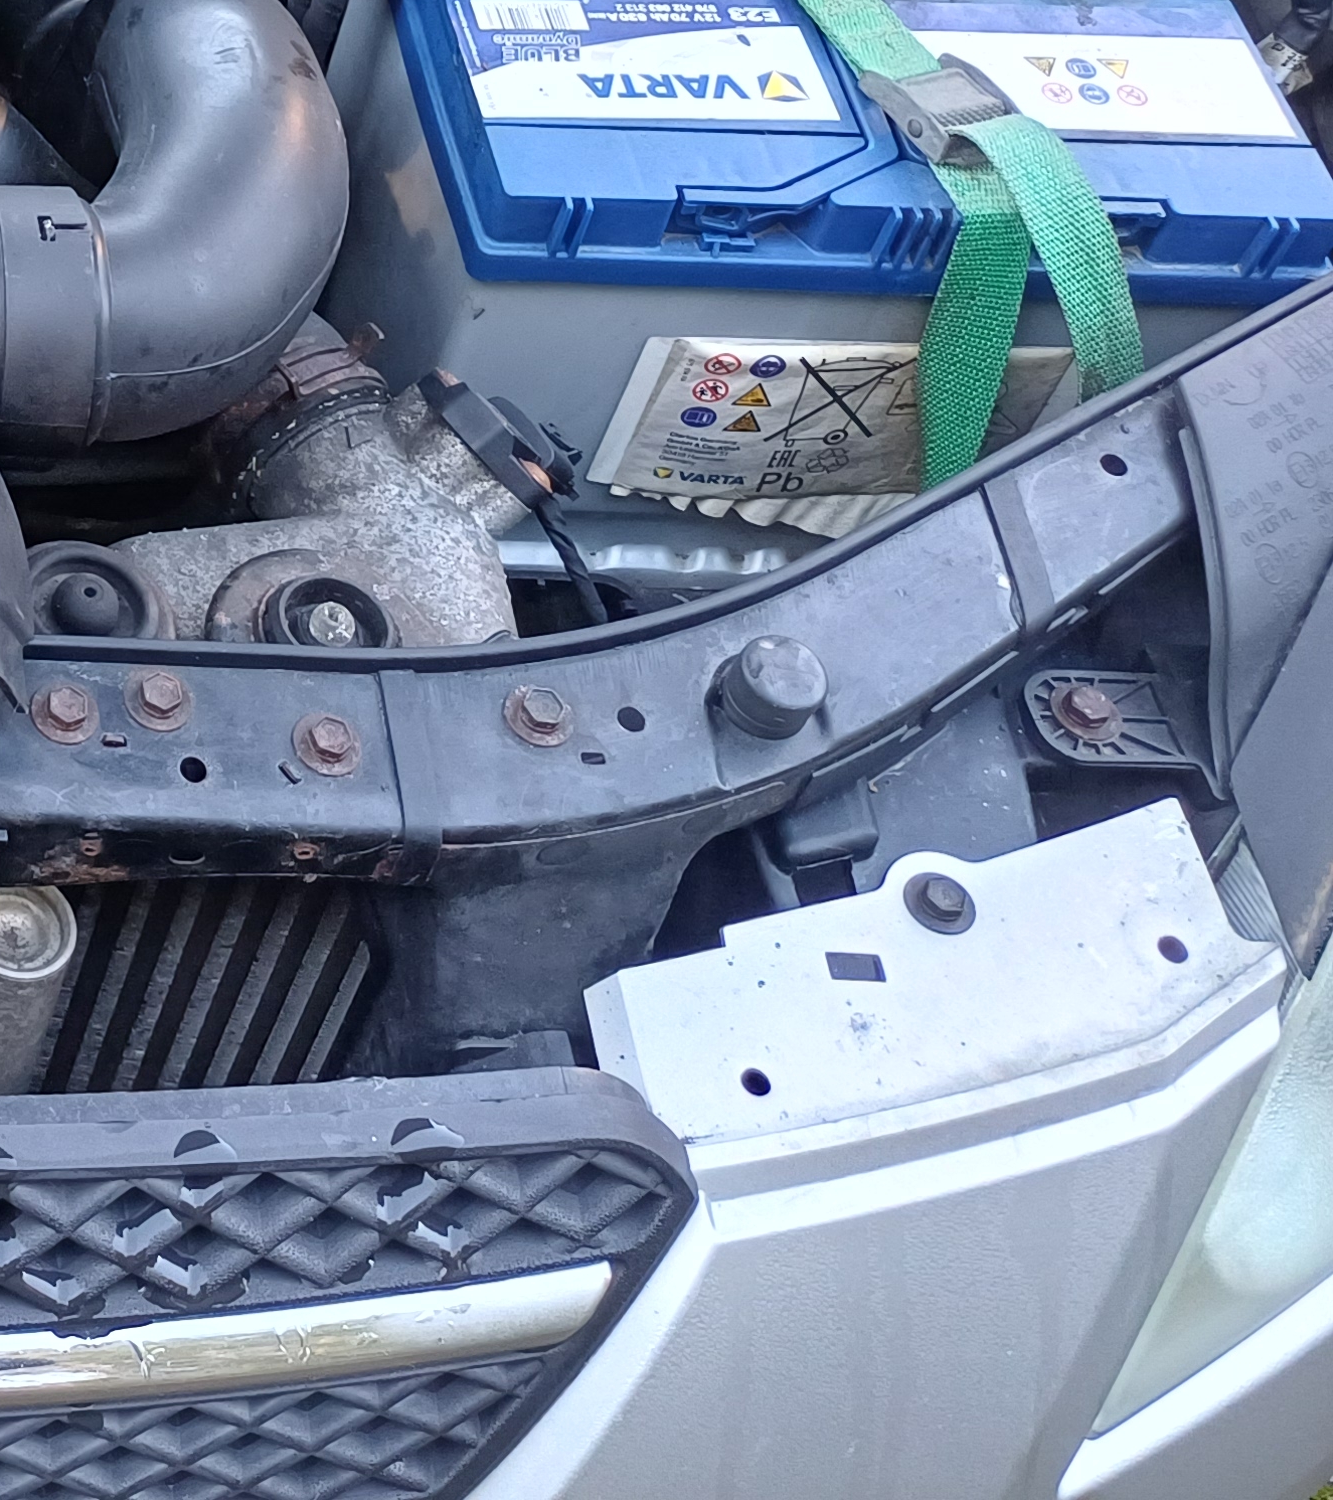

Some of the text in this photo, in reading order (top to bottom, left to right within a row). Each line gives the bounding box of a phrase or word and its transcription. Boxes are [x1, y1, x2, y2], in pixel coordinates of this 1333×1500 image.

[693, 11, 723, 23] 12V
[727, 7, 782, 24] E23
[492, 31, 581, 49] Dynamic
[501, 45, 581, 64] BLUE
[575, 73, 752, 100] VARTA
[766, 449, 802, 468] EAC
[678, 470, 745, 486] VARTA
[755, 471, 804, 493] Pb
